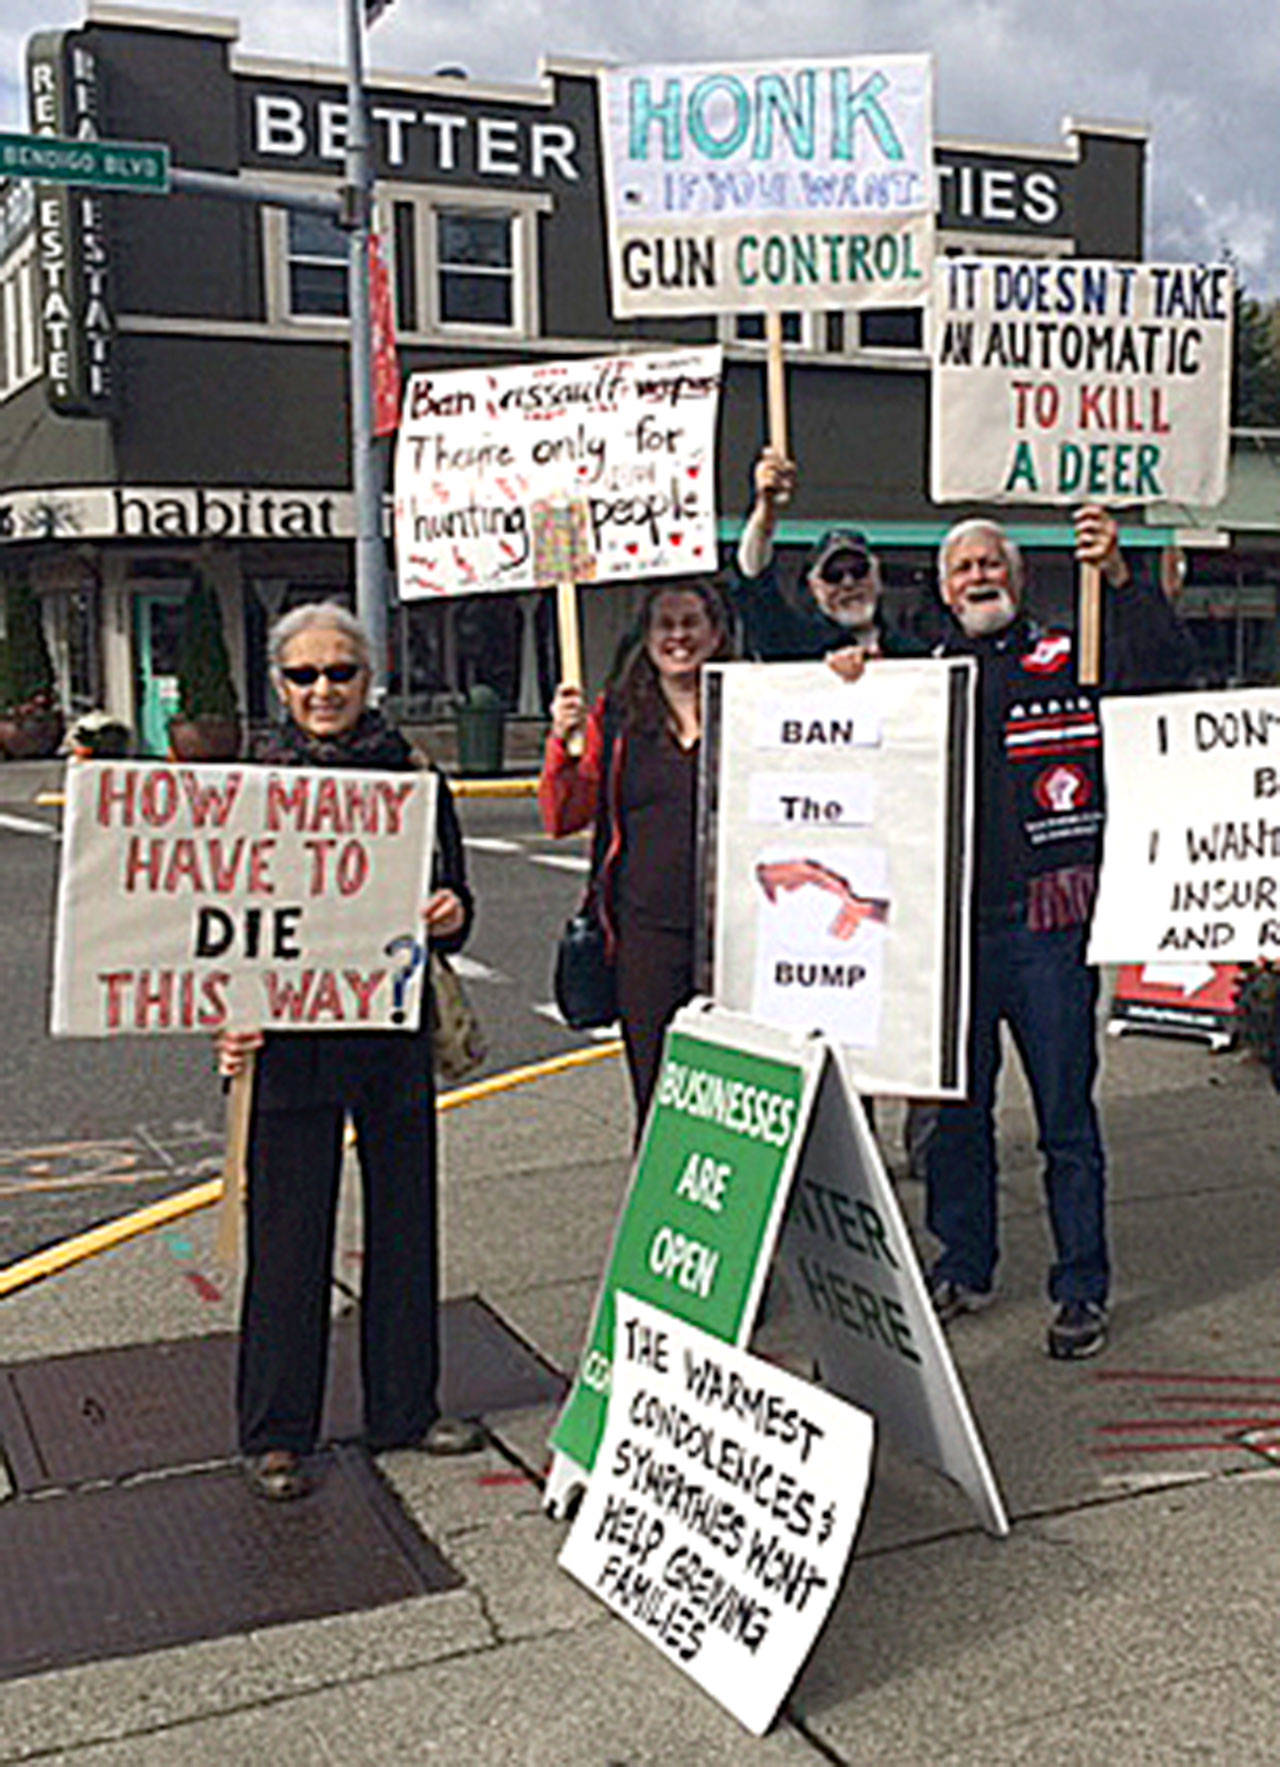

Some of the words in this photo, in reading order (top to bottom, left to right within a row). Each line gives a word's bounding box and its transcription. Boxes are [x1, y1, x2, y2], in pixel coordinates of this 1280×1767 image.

[255, 95, 580, 180] BETTER
[628, 67, 904, 161] HONK
[3, 145, 96, 174] BENDIGO
[103, 153, 159, 178] BLVD
[799, 170, 920, 208] WANT
[41, 199, 71, 379] ESTATE
[621, 236, 717, 290] GUN
[736, 231, 923, 287] CONTROL
[950, 263, 981, 312] IT
[1150, 266, 1228, 321] TAKE
[940, 321, 974, 366] AN
[982, 322, 1203, 375] AUTOMATIC
[411, 380, 475, 421] Ban
[1011, 381, 1060, 429] TO
[1079, 384, 1171, 434] KILL
[532, 423, 606, 484] only
[634, 414, 685, 454] for
[1005, 440, 1038, 493] A
[1058, 444, 1162, 496] DEER
[113, 490, 335, 535] habitat
[410, 494, 530, 577] hunting
[588, 476, 699, 553] people
[780, 719, 854, 745] BAN
[1157, 714, 1169, 755] I
[97, 769, 243, 828] HOW
[265, 772, 414, 835] MANY
[779, 796, 845, 822] The
[124, 836, 277, 894] HAVE
[304, 838, 370, 896] TO
[1148, 829, 1160, 865] I
[193, 906, 303, 959] DIE
[1157, 922, 1236, 951] AND
[98, 970, 231, 1029] THIS
[774, 961, 867, 989] BUMP
[659, 1062, 796, 1147] BUSINESSES
[676, 1152, 733, 1213] ARE
[649, 1226, 721, 1299] OPEN
[798, 1256, 923, 1365] HERE
[625, 1318, 669, 1374] THE
[684, 1347, 824, 1463] WARMEST
[630, 1389, 815, 1537] CONDOLENCES
[611, 1438, 746, 1558] SYMPATHIES
[594, 1493, 666, 1566] HELP
[596, 1555, 706, 1662] FAMILIES
